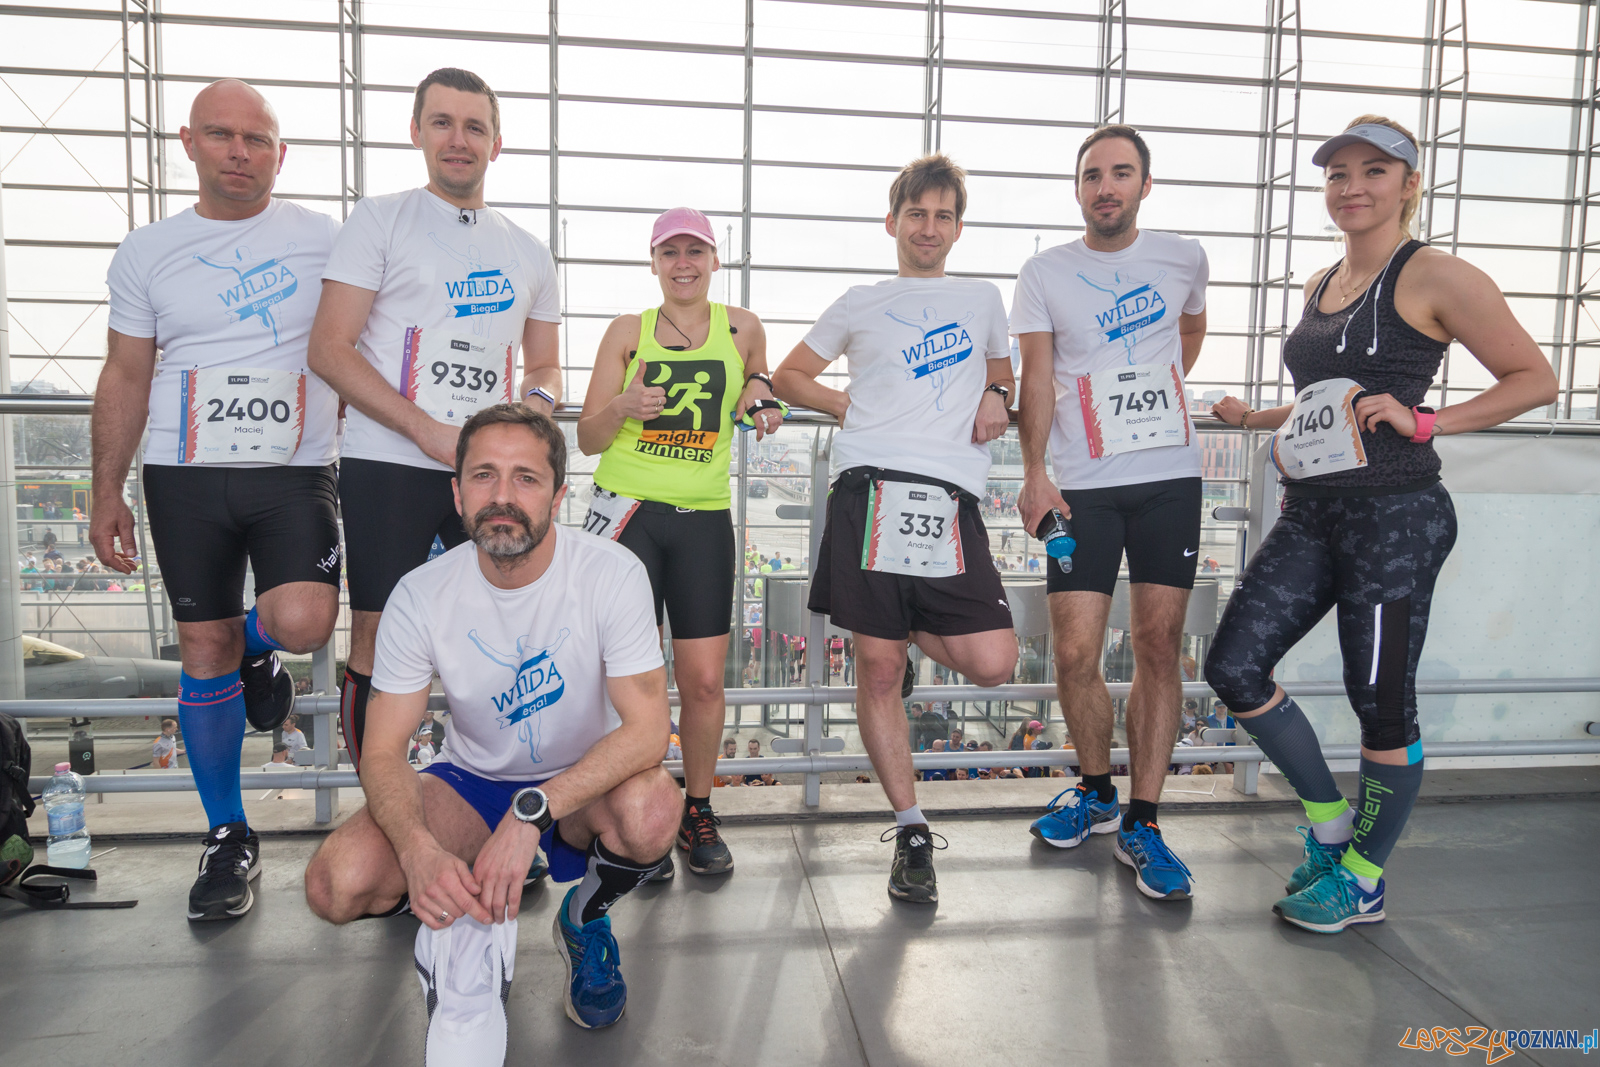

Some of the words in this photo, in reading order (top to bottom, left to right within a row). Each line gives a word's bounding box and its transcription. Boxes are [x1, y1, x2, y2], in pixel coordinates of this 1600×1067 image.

[217, 265, 295, 307] WILDA
[445, 278, 514, 298] WILDA
[252, 292, 284, 311] Biega!
[470, 302, 499, 314] Biega!
[1095, 290, 1165, 327] WILDA
[1120, 316, 1151, 334] Biega!
[902, 329, 972, 365] WILDA
[928, 354, 958, 372] Biega!
[431, 361, 497, 393] 9339
[207, 398, 290, 423] 2400
[1108, 389, 1169, 416] 7491
[234, 426, 264, 435] Maciej
[656, 430, 706, 445] night
[636, 440, 713, 463] runners
[1293, 438, 1325, 451] Marcelina
[899, 512, 945, 539] 333
[907, 540, 934, 551] Andrzej
